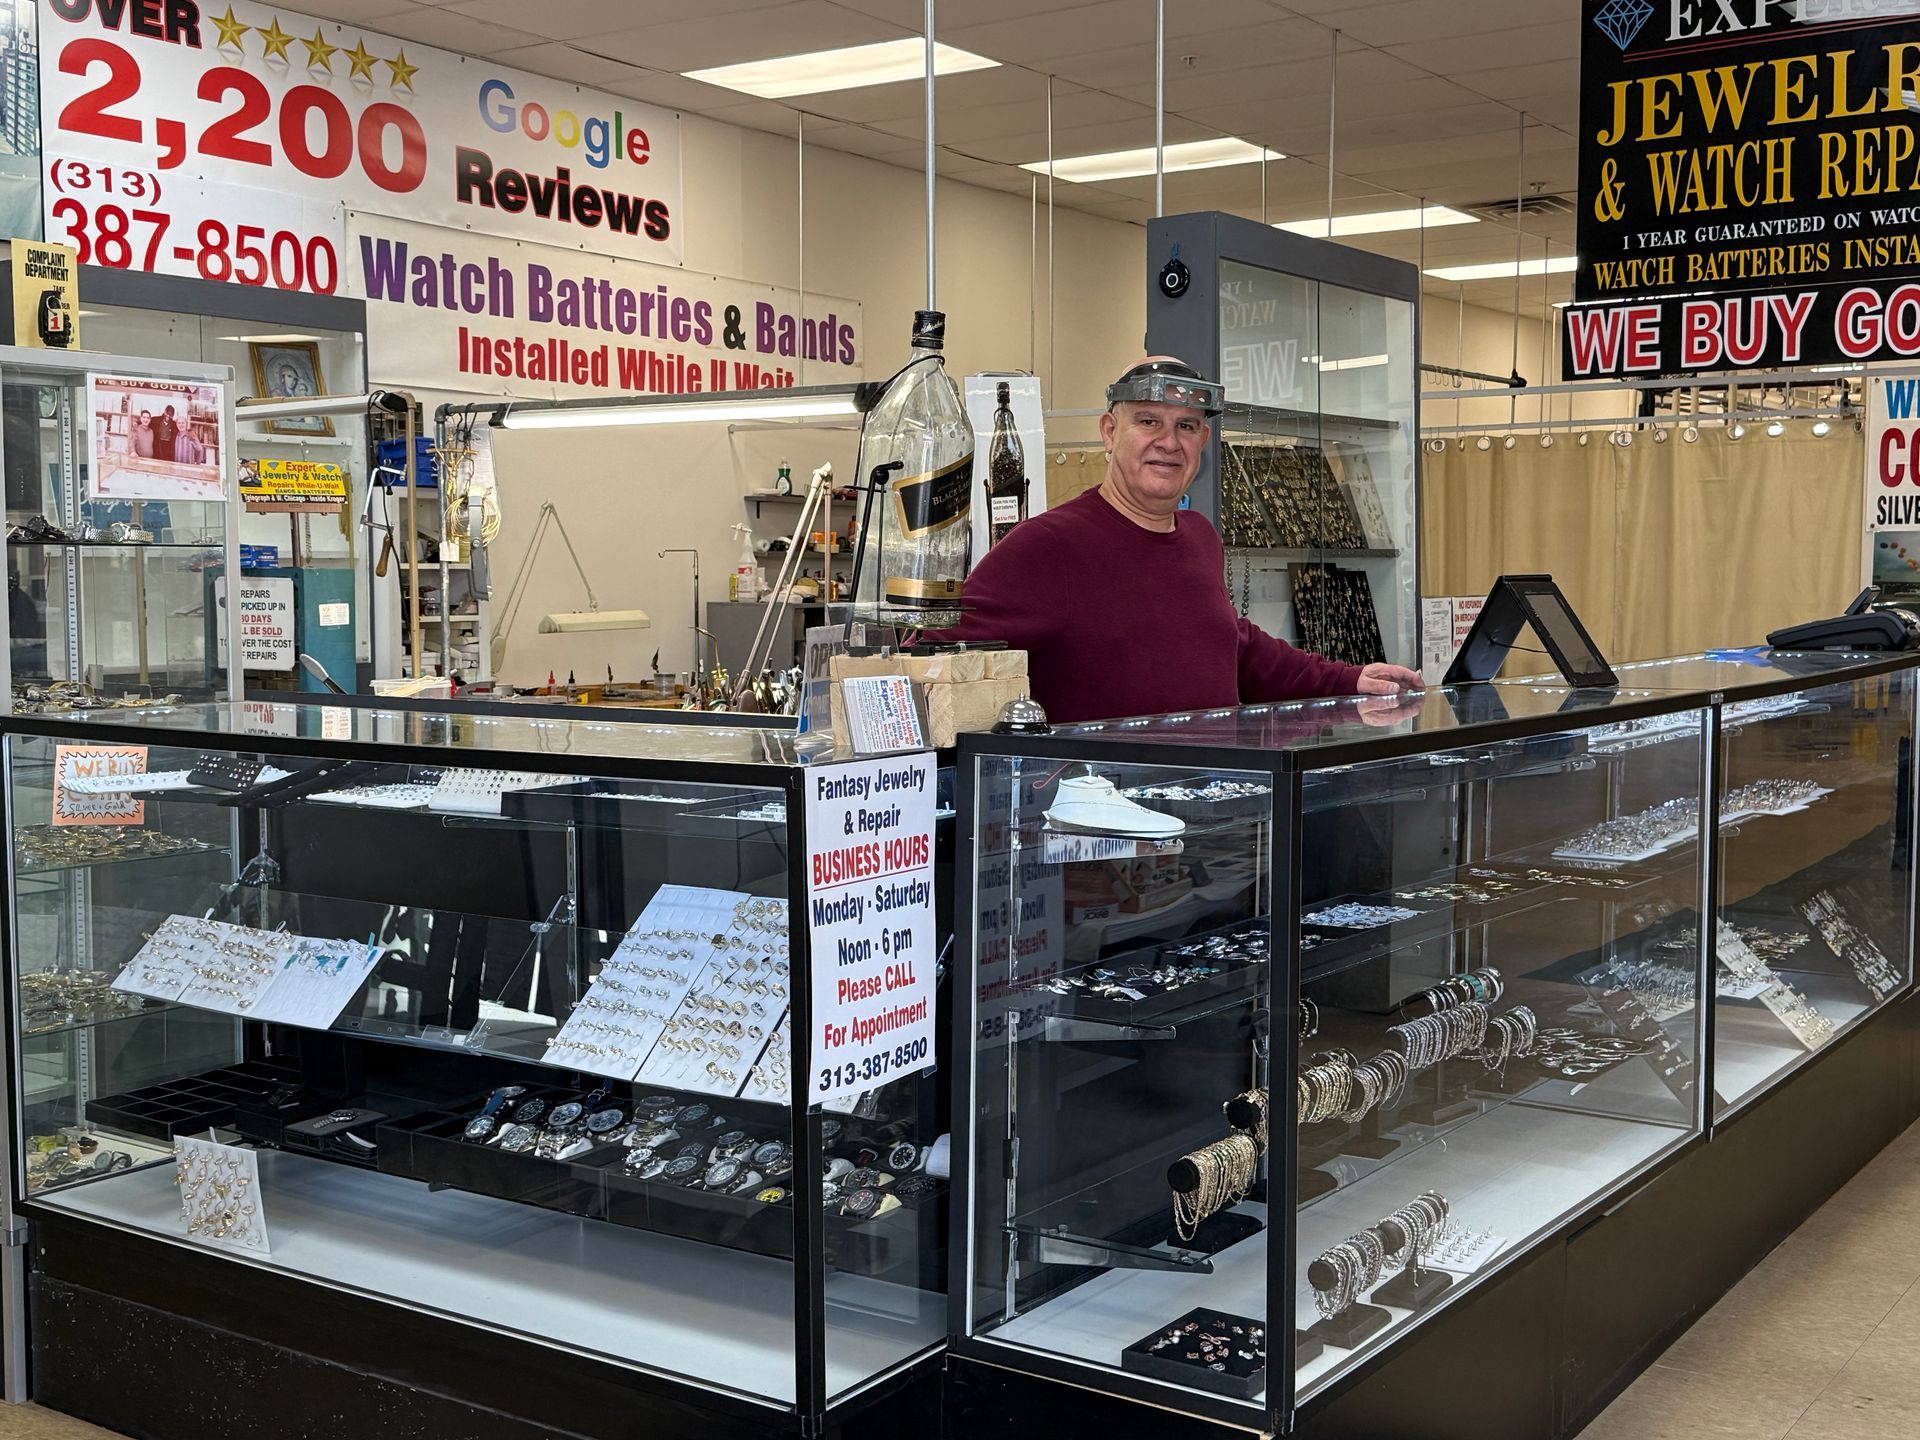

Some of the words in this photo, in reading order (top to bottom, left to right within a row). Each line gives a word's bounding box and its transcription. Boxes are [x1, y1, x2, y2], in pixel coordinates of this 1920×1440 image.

[57, 37, 427, 194] 2,200
[478, 79, 651, 169] Google
[49, 158, 163, 206] (313)
[455, 145, 671, 241] Reviews
[1594, 158, 1626, 223] &
[1646, 137, 1796, 217] WATCH
[52, 198, 338, 296] 387-8500
[1622, 235, 1629, 250] 1
[1636, 229, 1687, 249] YEAR
[1695, 213, 1825, 244] GUARANTEED
[1834, 212, 1861, 230] ON
[25, 263, 69, 281] DEPARTMENT
[27, 249, 66, 267] COMPLAINT
[1593, 255, 1674, 291] WATCH
[1687, 242, 1830, 284] BATTERIES
[1842, 233, 1920, 270] INSTA
[359, 235, 514, 320] Watch
[528, 263, 713, 346] Batteries
[723, 304, 747, 351] &
[755, 301, 856, 366] Bands
[50, 316, 60, 330] 1
[1567, 302, 1662, 376] WE
[1681, 289, 1819, 368] BUY
[458, 327, 608, 388] Installed
[617, 347, 702, 394] While
[734, 362, 794, 391] Wait
[98, 378, 117, 386] WE
[121, 380, 145, 388] BUY
[150, 382, 186, 391] GOLD
[1885, 380, 1920, 419] W
[263, 470, 300, 481] Jewelry
[302, 472, 309, 481] &
[312, 472, 342, 481] Watch
[267, 481, 295, 489] Repairs
[286, 461, 316, 472] Expert
[932, 488, 958, 505] BLACK
[240, 590, 270, 598] REPAIRS
[241, 602, 267, 611] PICKED
[268, 602, 277, 611] UP
[279, 602, 286, 611] IN
[250, 627, 261, 635] BE
[262, 627, 283, 636] SOLD
[251, 615, 272, 623] DAYS
[246, 651, 277, 660] REPAIRS
[258, 639, 271, 648] THE
[273, 639, 292, 648] COST
[880, 680, 894, 718] Expert
[817, 774, 871, 801] Fantasy
[875, 765, 926, 794] Jewelry
[844, 810, 853, 835] &
[858, 804, 901, 836] Repair
[813, 844, 880, 887] BUSINESS
[884, 833, 929, 870] HOURS
[814, 893, 864, 928] Monday
[875, 880, 931, 913] Saturday
[838, 937, 871, 967] Noon
[882, 928, 890, 949] 6
[894, 928, 912, 957] pm
[838, 974, 881, 1005] Please
[885, 960, 915, 990] CALL
[824, 1023, 847, 1050] For
[851, 996, 927, 1047] Appointment
[820, 1037, 927, 1092] 313-387-8500
